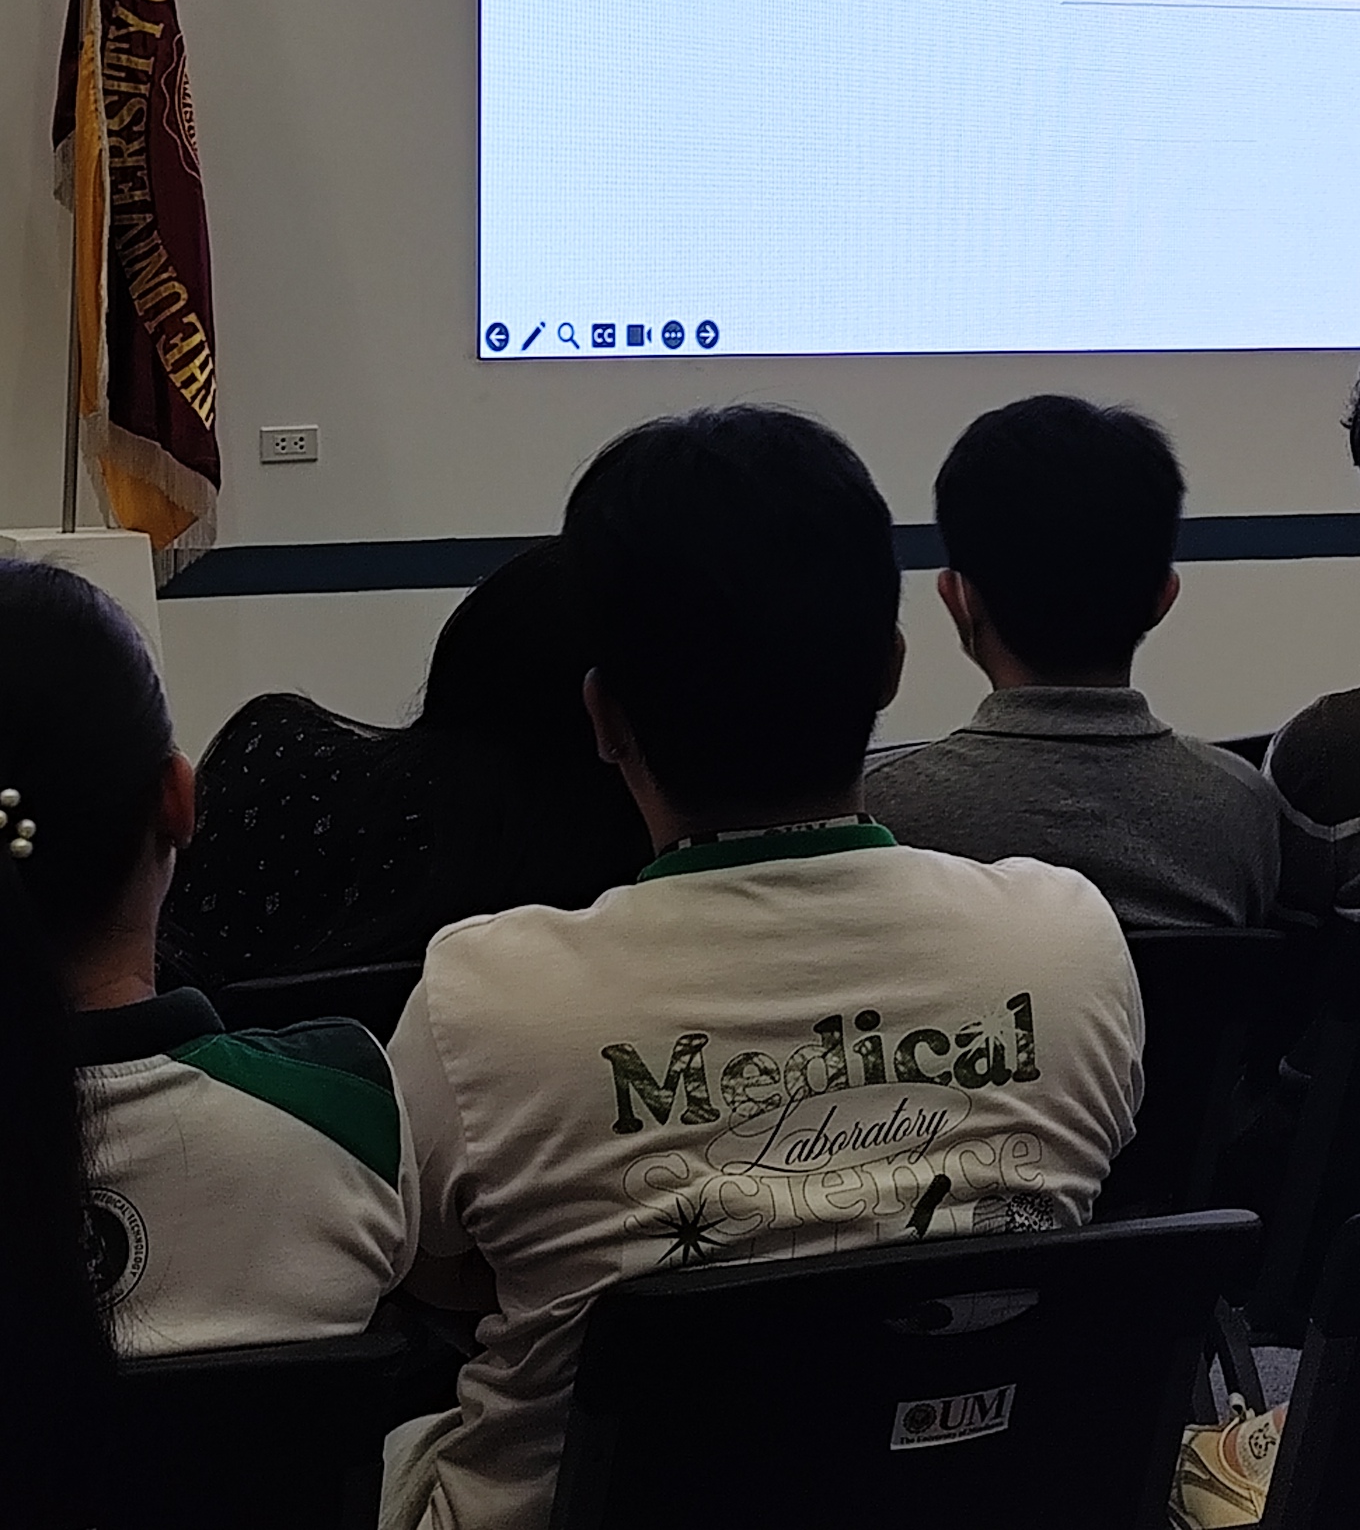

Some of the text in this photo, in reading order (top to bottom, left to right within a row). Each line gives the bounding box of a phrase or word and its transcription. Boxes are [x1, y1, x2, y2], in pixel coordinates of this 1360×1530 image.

[103, 1, 189, 334] UNIVERSITY
[592, 327, 614, 344] CC
[600, 991, 1041, 1135] Medical
[721, 1083, 951, 1177] Laboratory
[622, 1132, 1045, 1239] Science
[939, 1387, 1011, 1431] UM
